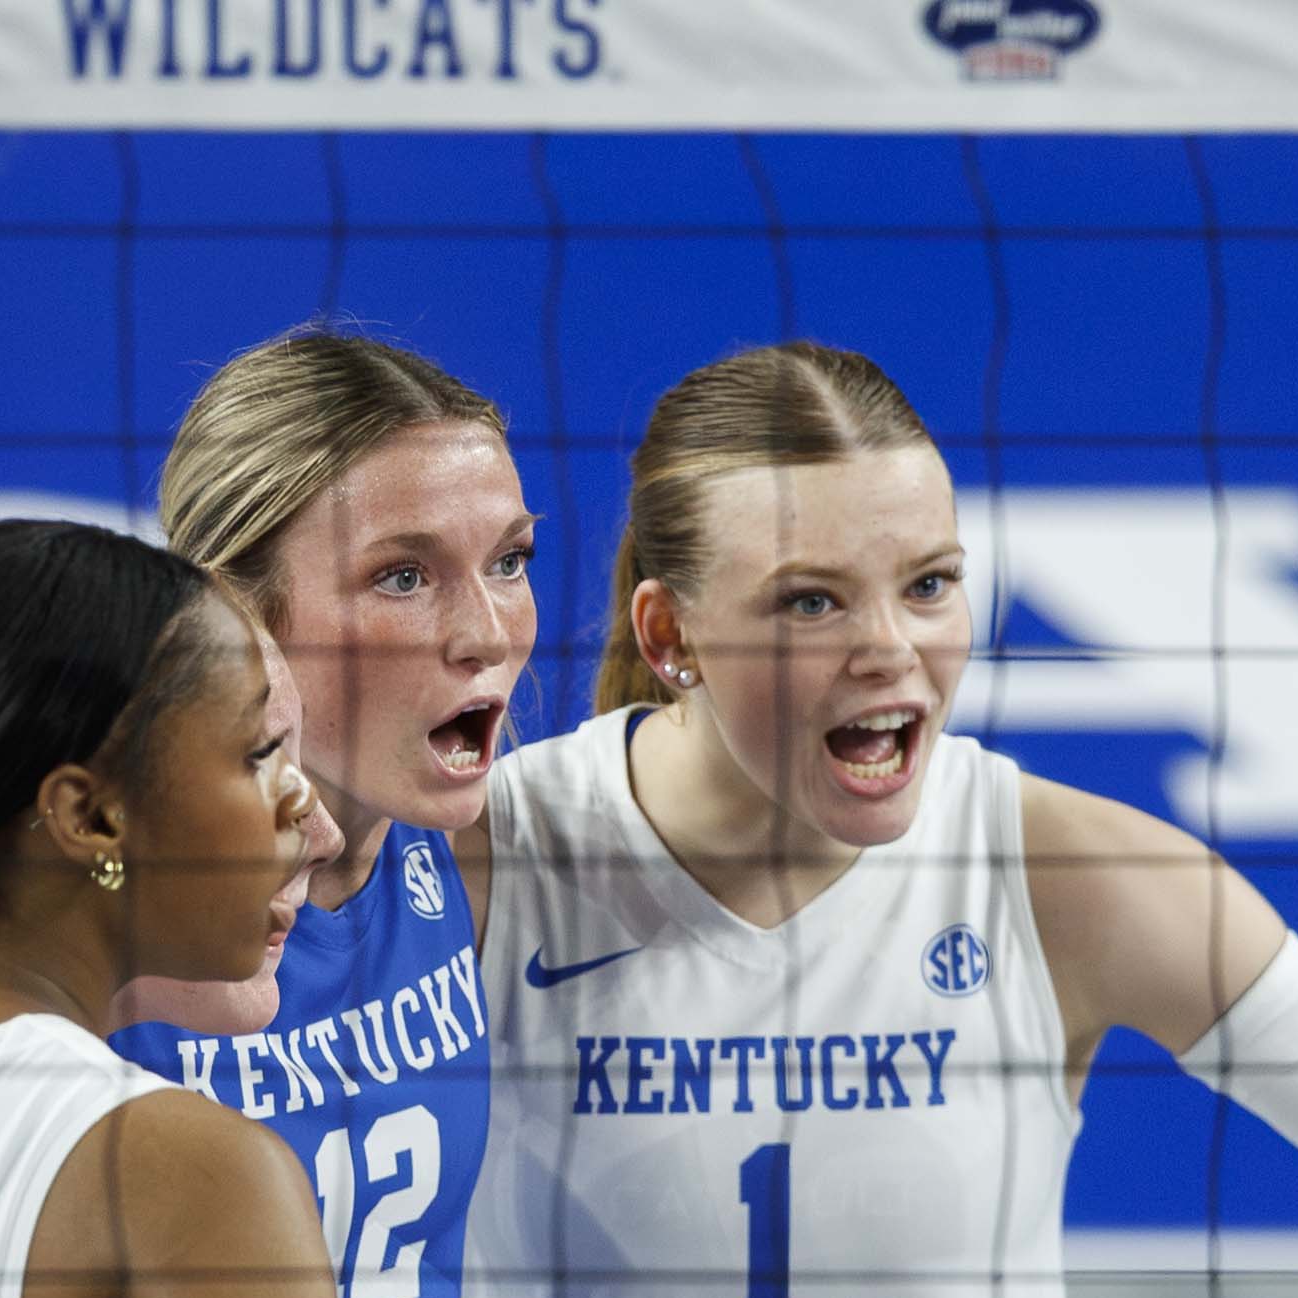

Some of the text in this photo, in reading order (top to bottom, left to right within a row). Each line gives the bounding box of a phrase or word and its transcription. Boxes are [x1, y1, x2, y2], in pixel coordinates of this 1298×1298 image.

[926, 927, 987, 993] SEC
[177, 945, 485, 1120] KENTUCKY
[572, 1029, 956, 1115] KENTUCKY
